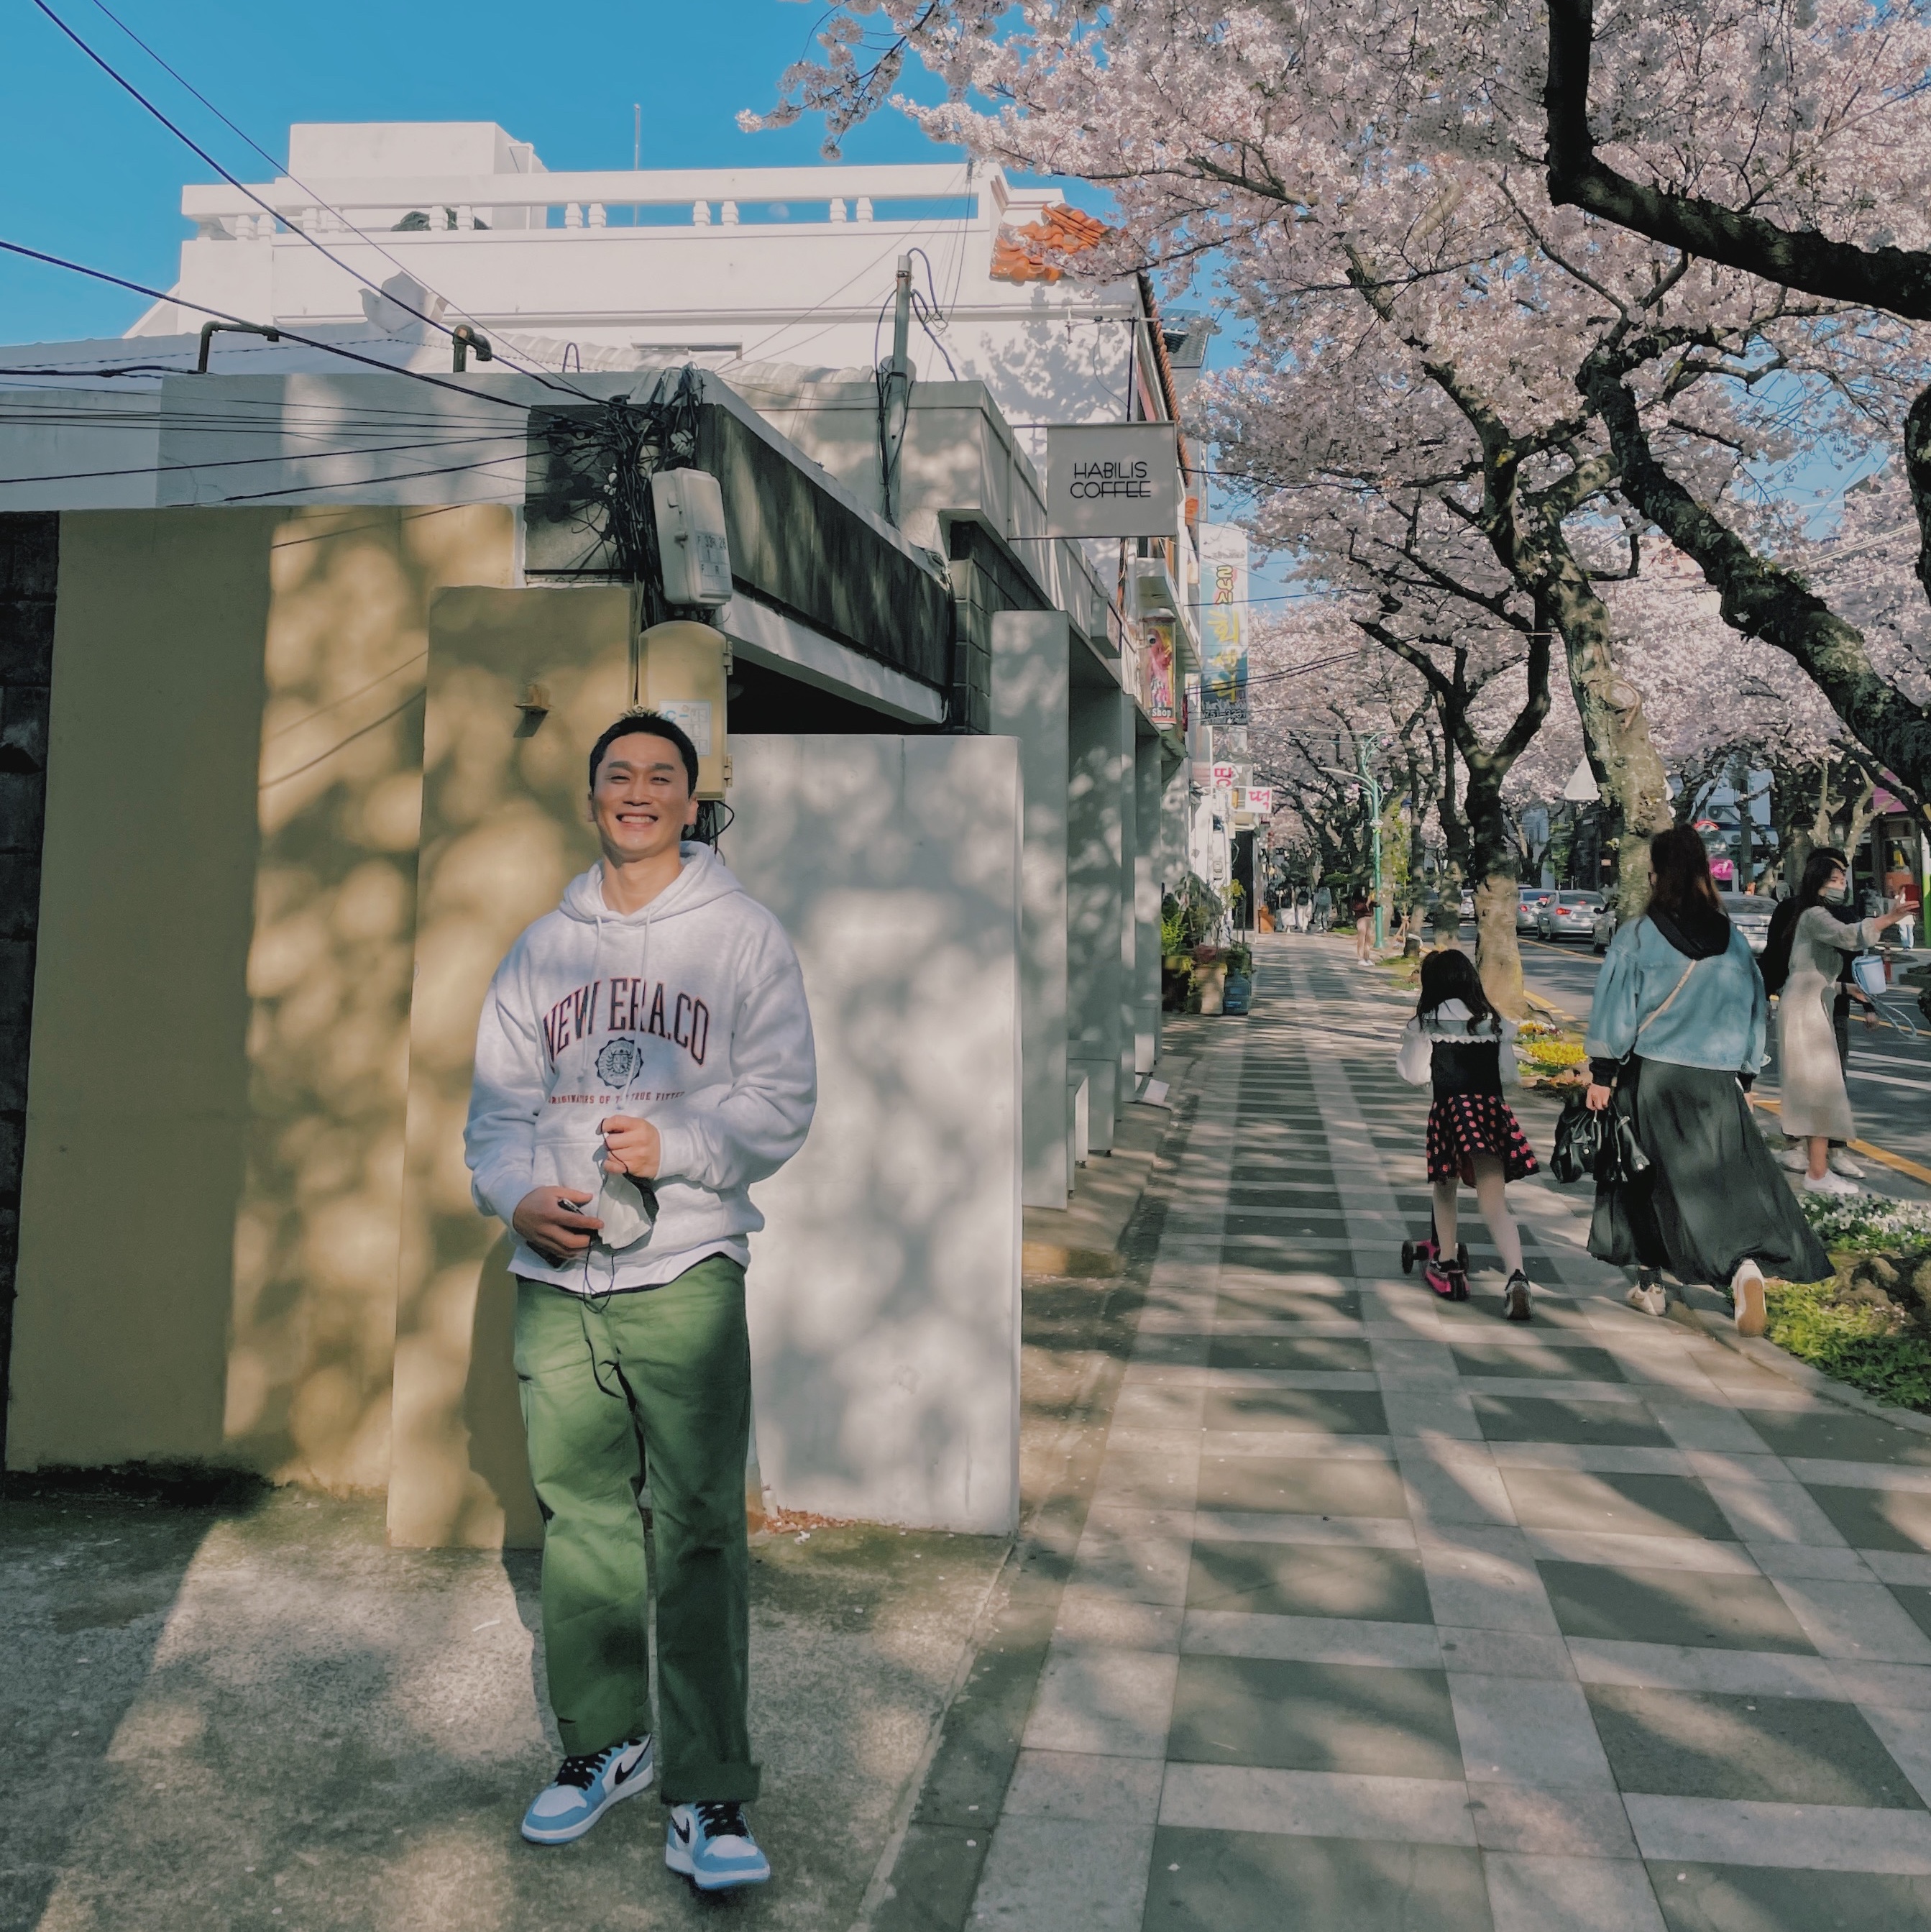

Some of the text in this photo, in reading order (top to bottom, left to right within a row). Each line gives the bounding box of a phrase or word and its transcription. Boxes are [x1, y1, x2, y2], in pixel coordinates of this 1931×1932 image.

[1074, 461, 1148, 479] HABILIS
[1070, 481, 1152, 498] COFFEE
[1152, 708, 1171, 718] Shop
[599, 1094, 611, 1104] OF
[630, 1091, 651, 1102] TRUE
